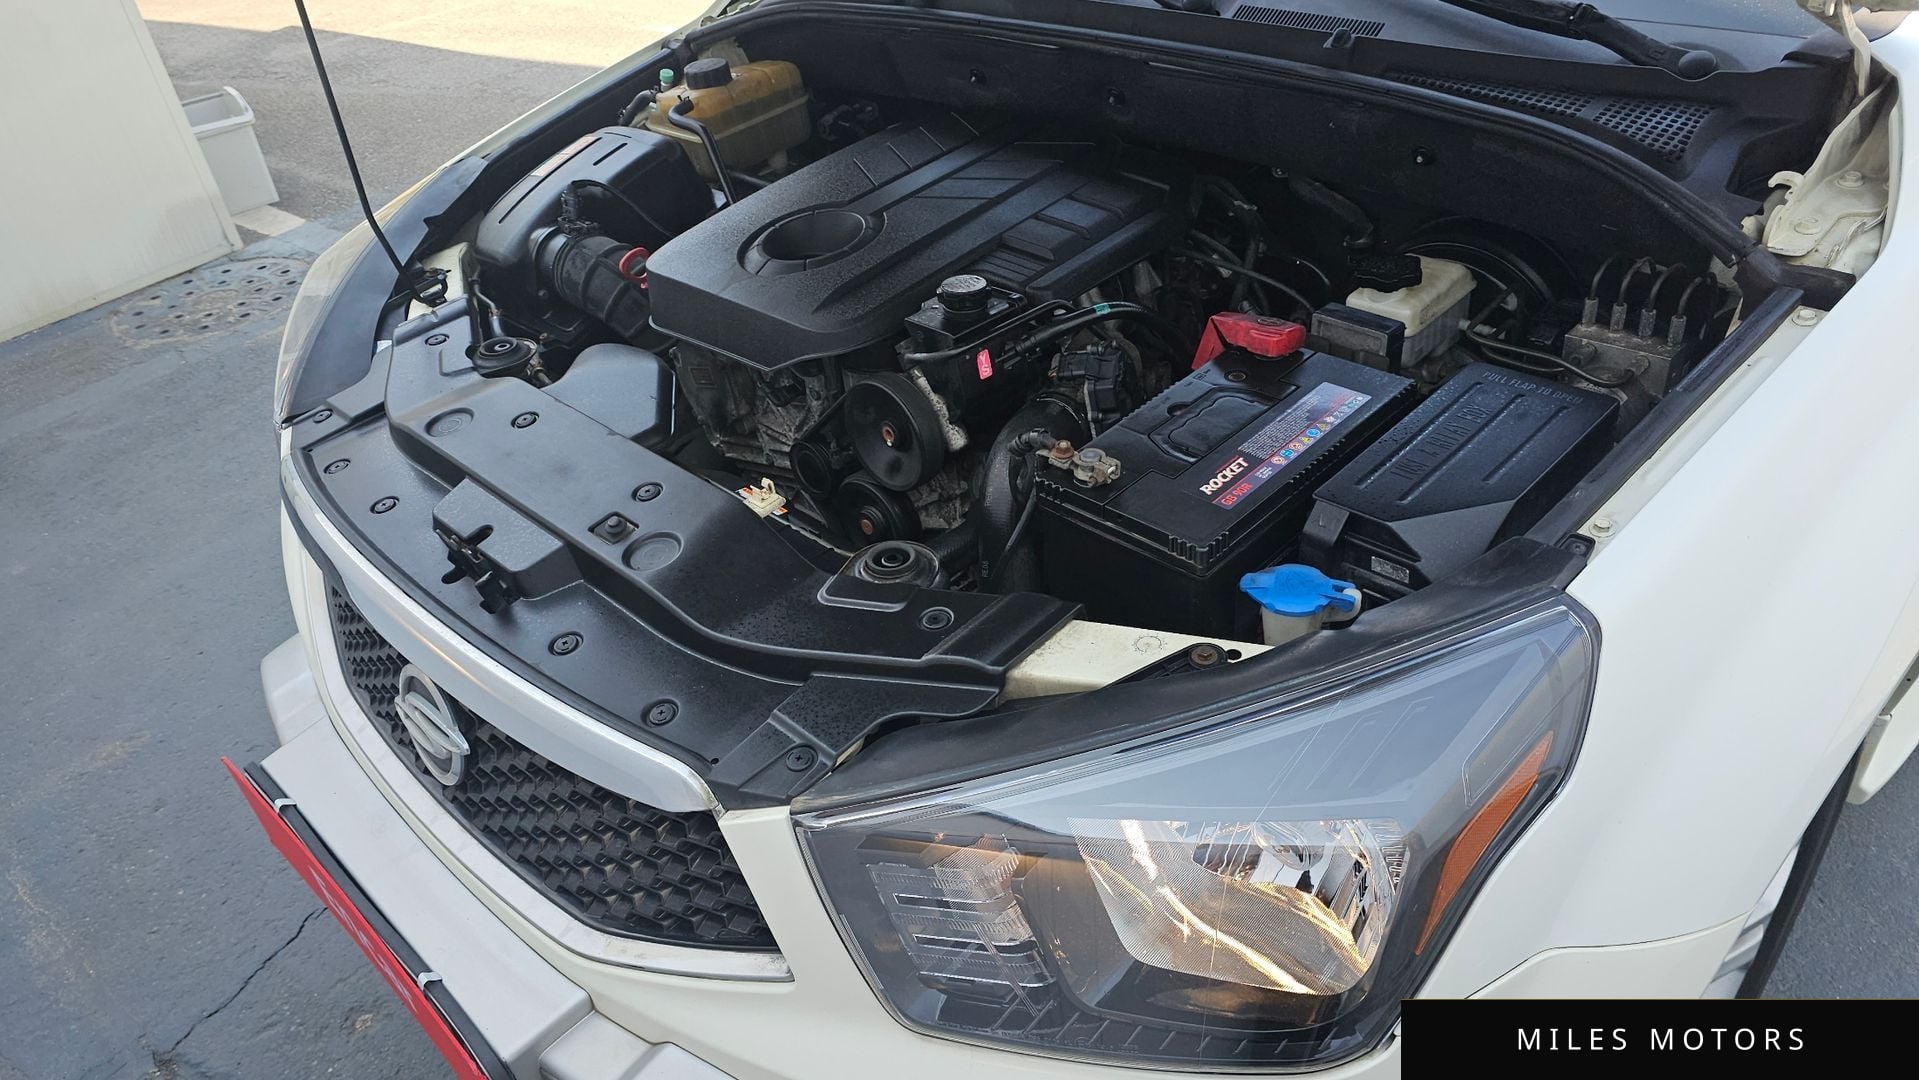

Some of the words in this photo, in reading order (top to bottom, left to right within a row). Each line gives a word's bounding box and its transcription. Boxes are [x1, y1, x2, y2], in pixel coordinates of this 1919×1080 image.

[1482, 371, 1508, 384] PULL
[1508, 378, 1537, 390] FLAP
[1553, 391, 1585, 404] OPEN
[1199, 457, 1249, 496] ROCKET
[1221, 494, 1238, 506] GB
[1232, 482, 1253, 496] 90R
